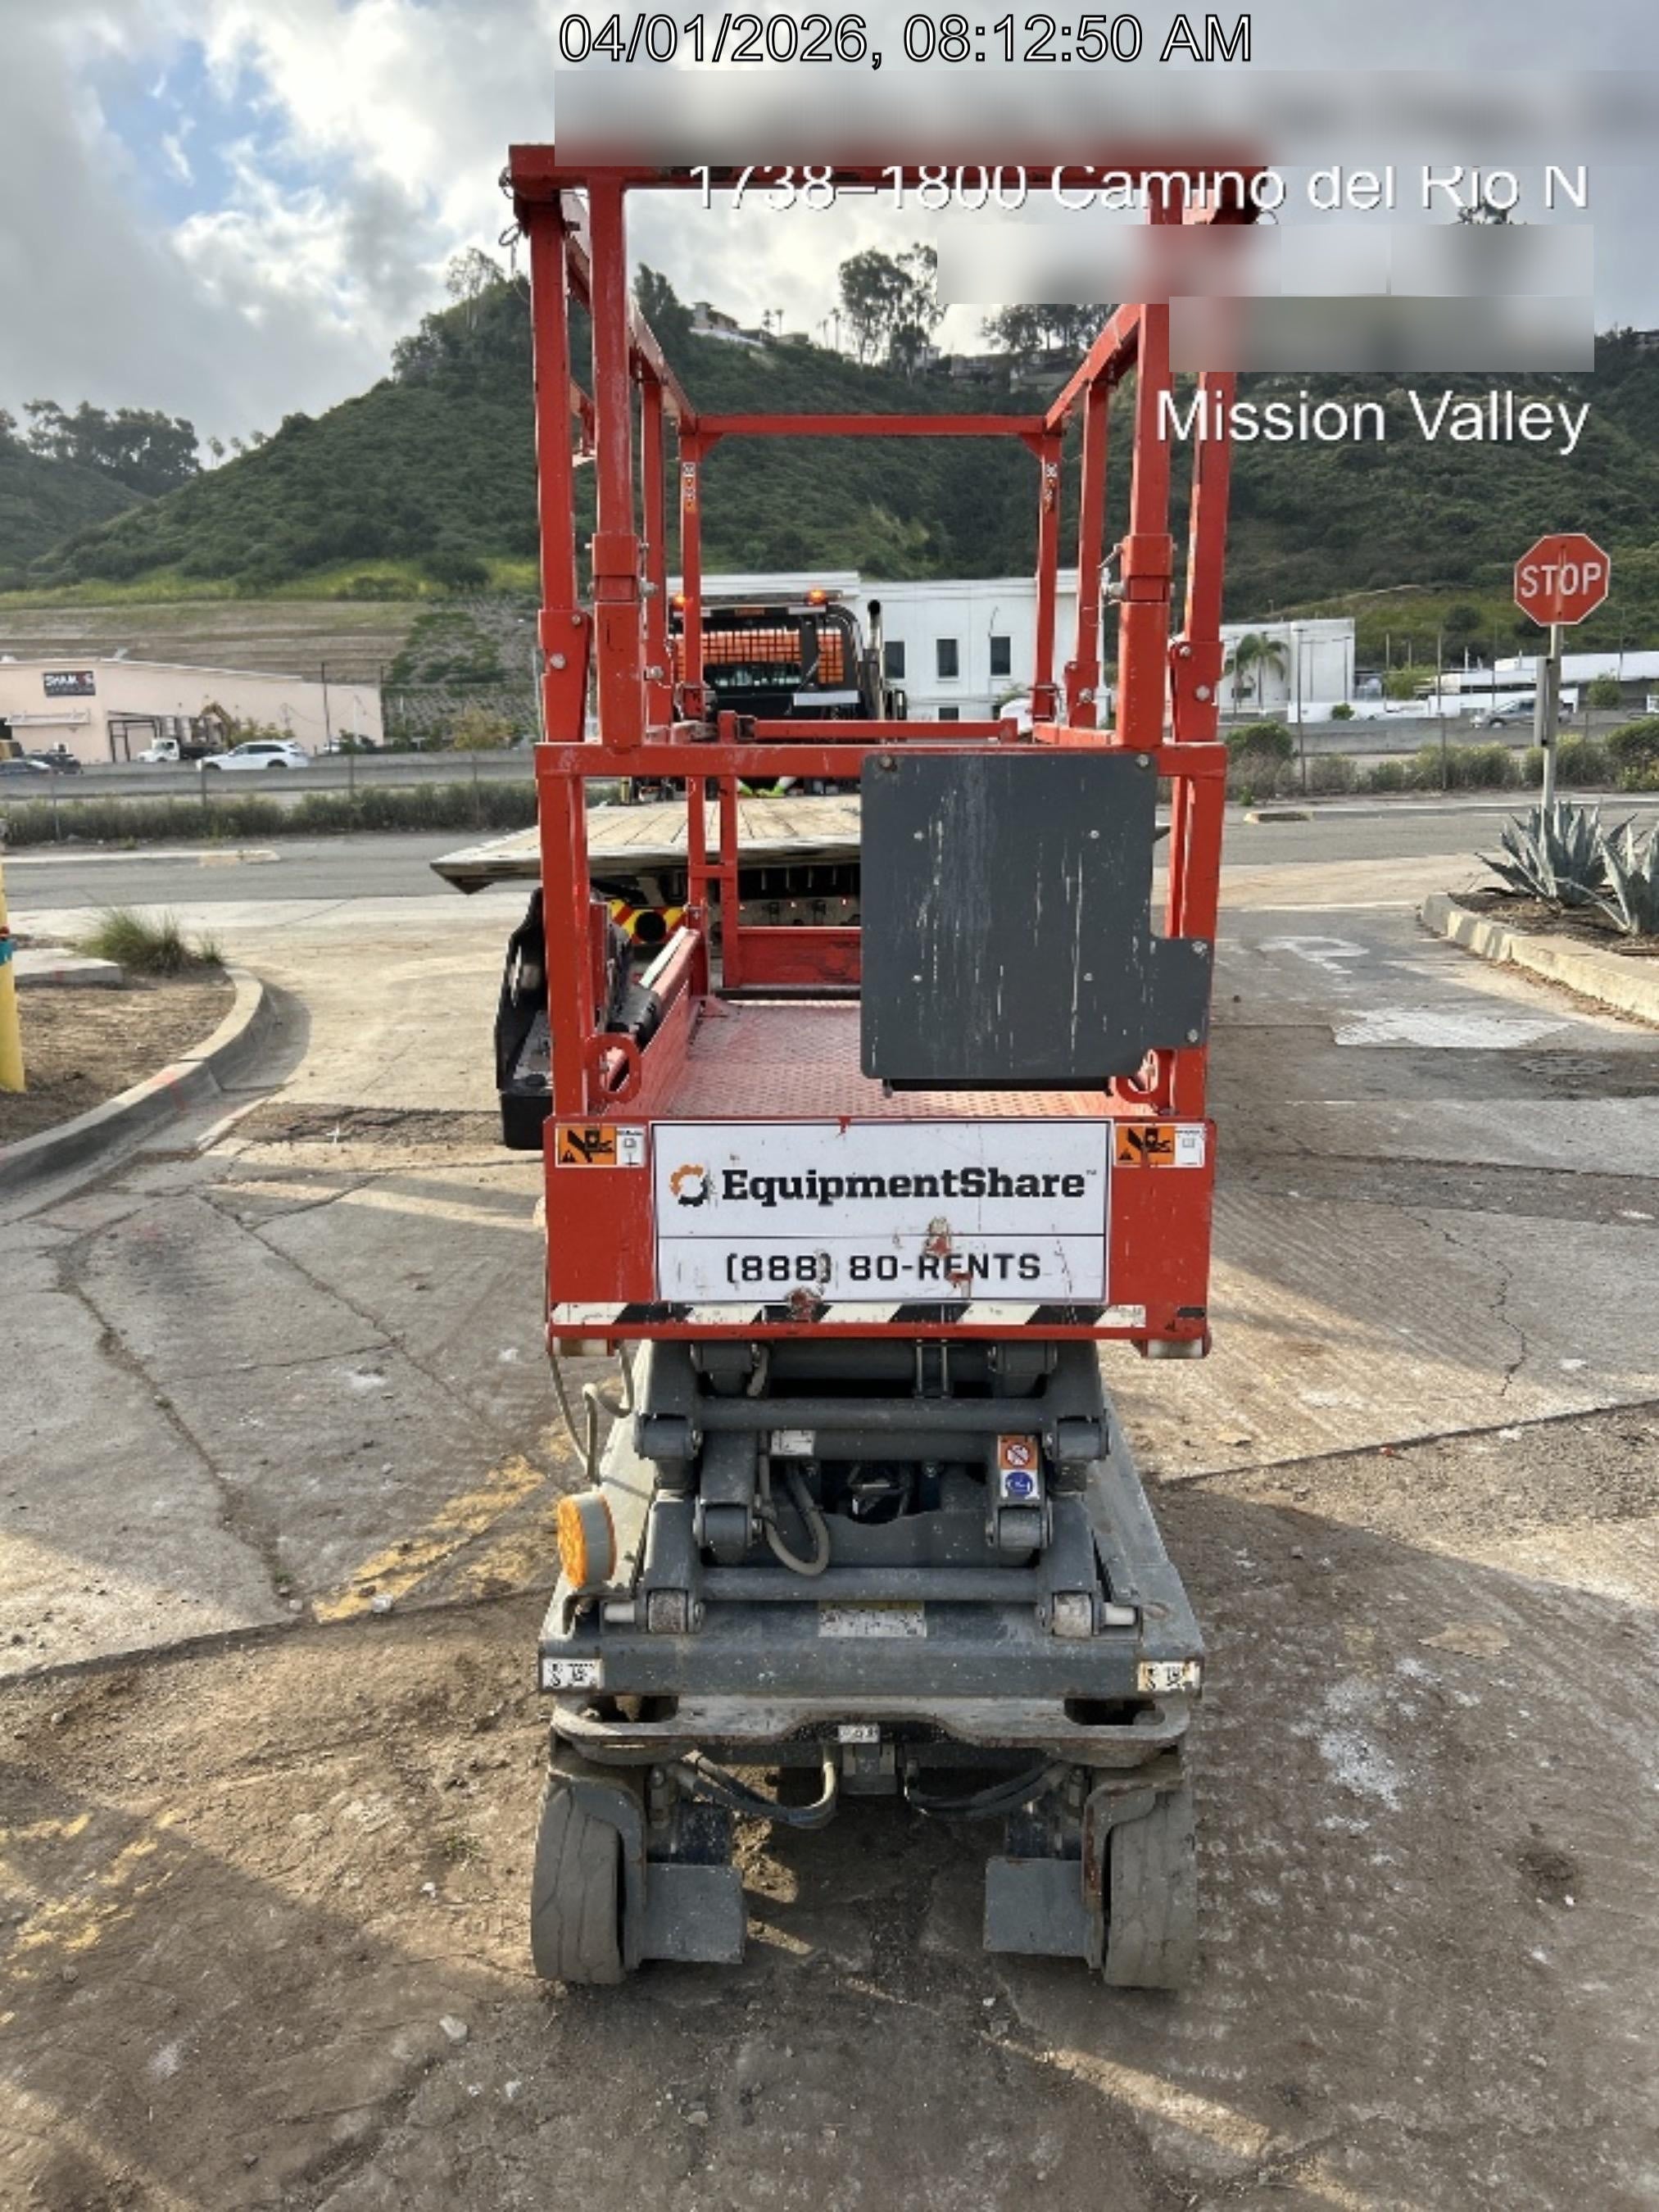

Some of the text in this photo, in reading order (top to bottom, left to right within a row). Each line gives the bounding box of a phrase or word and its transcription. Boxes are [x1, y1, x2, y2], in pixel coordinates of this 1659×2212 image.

[1521, 562, 1602, 598] STOP
[721, 1167, 1086, 1208] EquipmentShare
[726, 1252, 1041, 1285] (888) 80-RENTS
